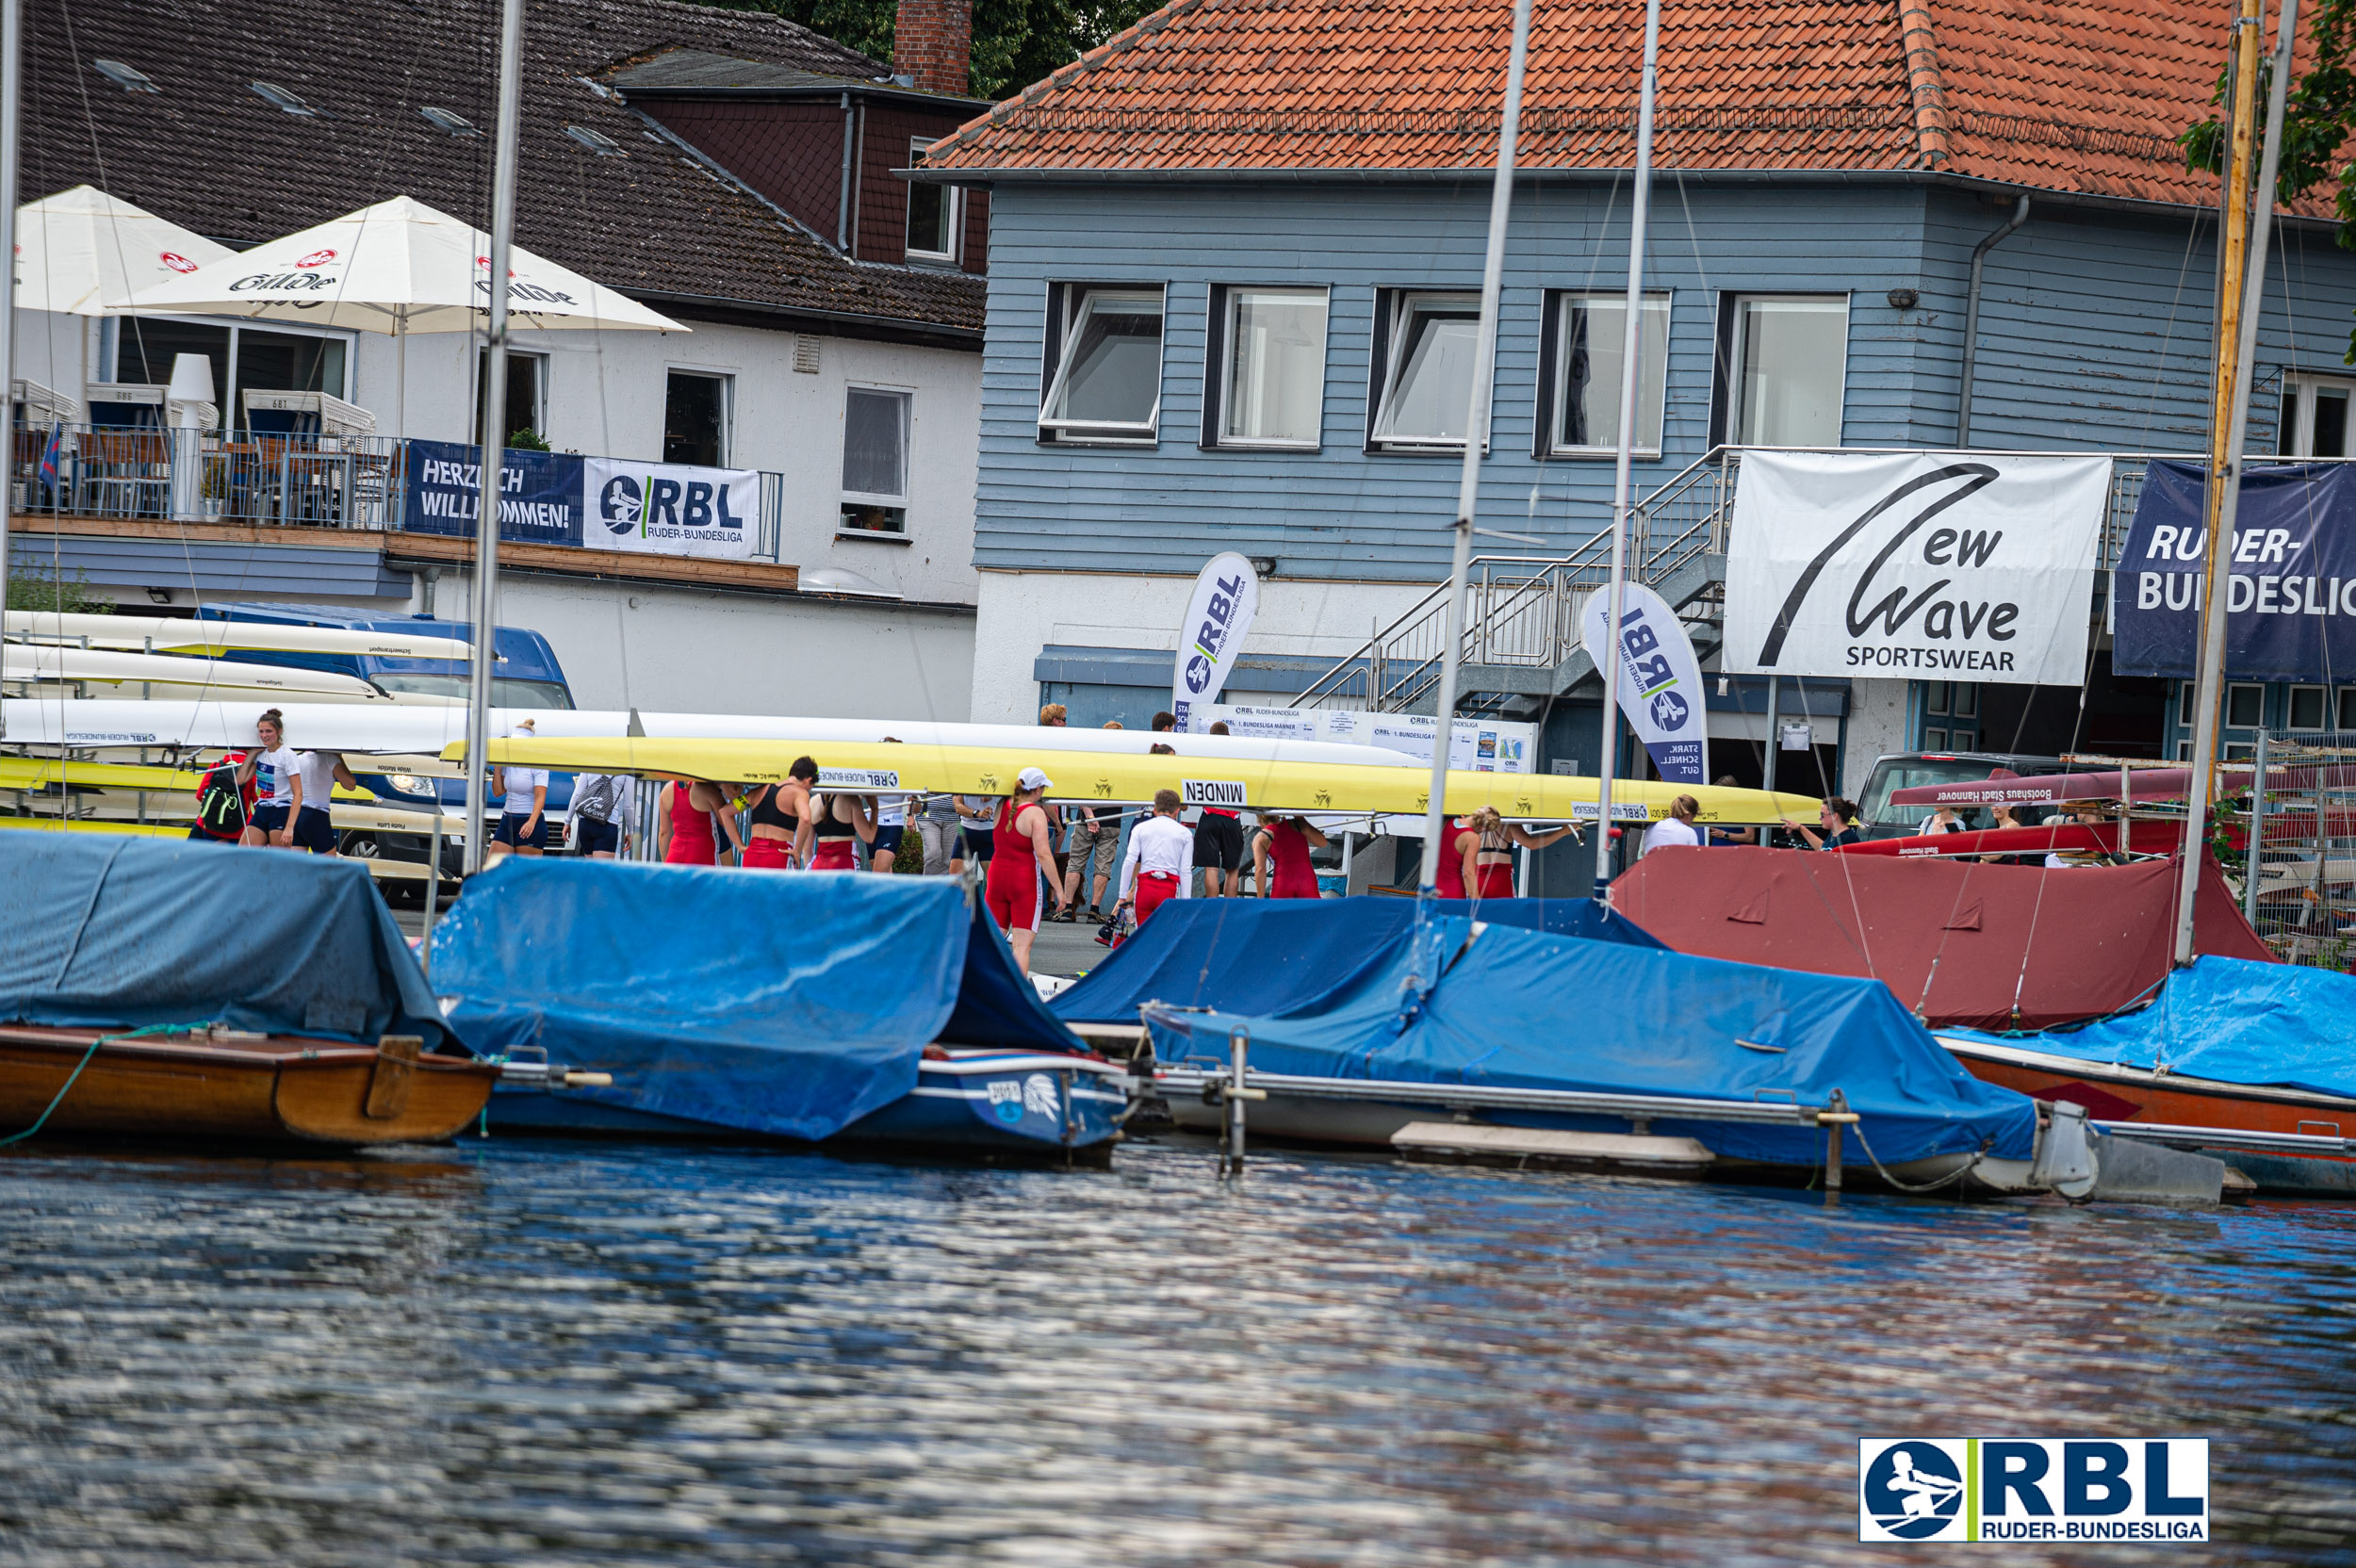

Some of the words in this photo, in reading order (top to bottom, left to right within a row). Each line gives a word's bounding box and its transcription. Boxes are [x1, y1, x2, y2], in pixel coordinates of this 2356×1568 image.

[229, 272, 336, 292] Gilde
[422, 459, 524, 493] HERZLCH
[421, 491, 569, 529] WILLKMMEN!
[648, 478, 743, 530] RBL
[647, 527, 743, 544] RUDER-BUNDESLIGA
[1197, 575, 1241, 655] RBL
[1215, 580, 1246, 658] RUDER-BUNDESLIGA
[1846, 580, 2020, 642] Wave
[1846, 645, 2015, 672] SPORTSWEAR
[1274, 721, 1295, 729] MÄNNER
[867, 775, 888, 786] RBL
[1186, 781, 1242, 803] MINDEN
[1937, 792, 1979, 802] Hannover
[1982, 790, 2004, 801] Stadt
[2006, 789, 2052, 800] Bootshaus
[1623, 808, 1640, 819] RBL
[1923, 846, 1939, 855] Stadt
